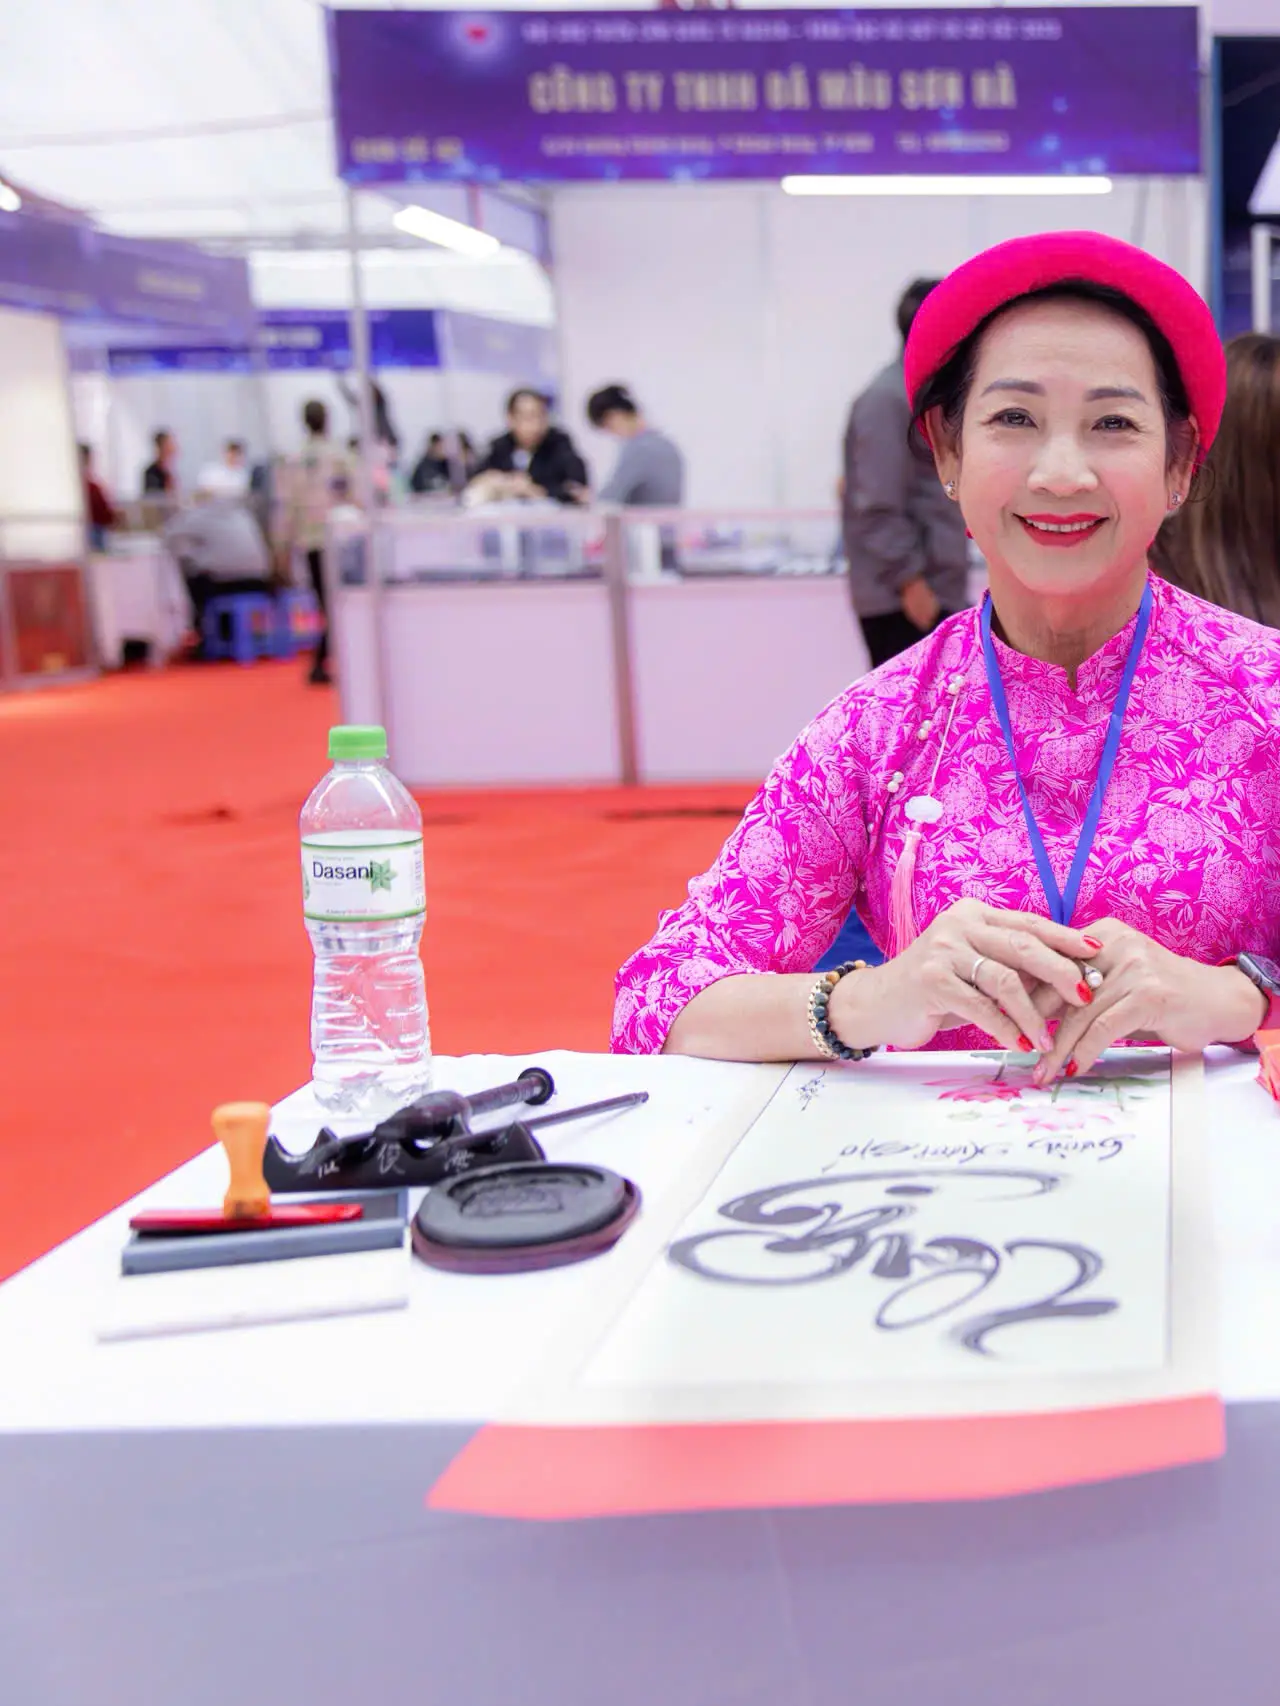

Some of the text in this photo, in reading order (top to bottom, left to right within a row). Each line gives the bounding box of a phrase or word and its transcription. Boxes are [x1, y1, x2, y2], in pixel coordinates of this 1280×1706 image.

[528, 63, 616, 112] CÔNG
[624, 71, 664, 111] TY
[673, 70, 758, 111] TNHH
[313, 860, 374, 881] Dasani
